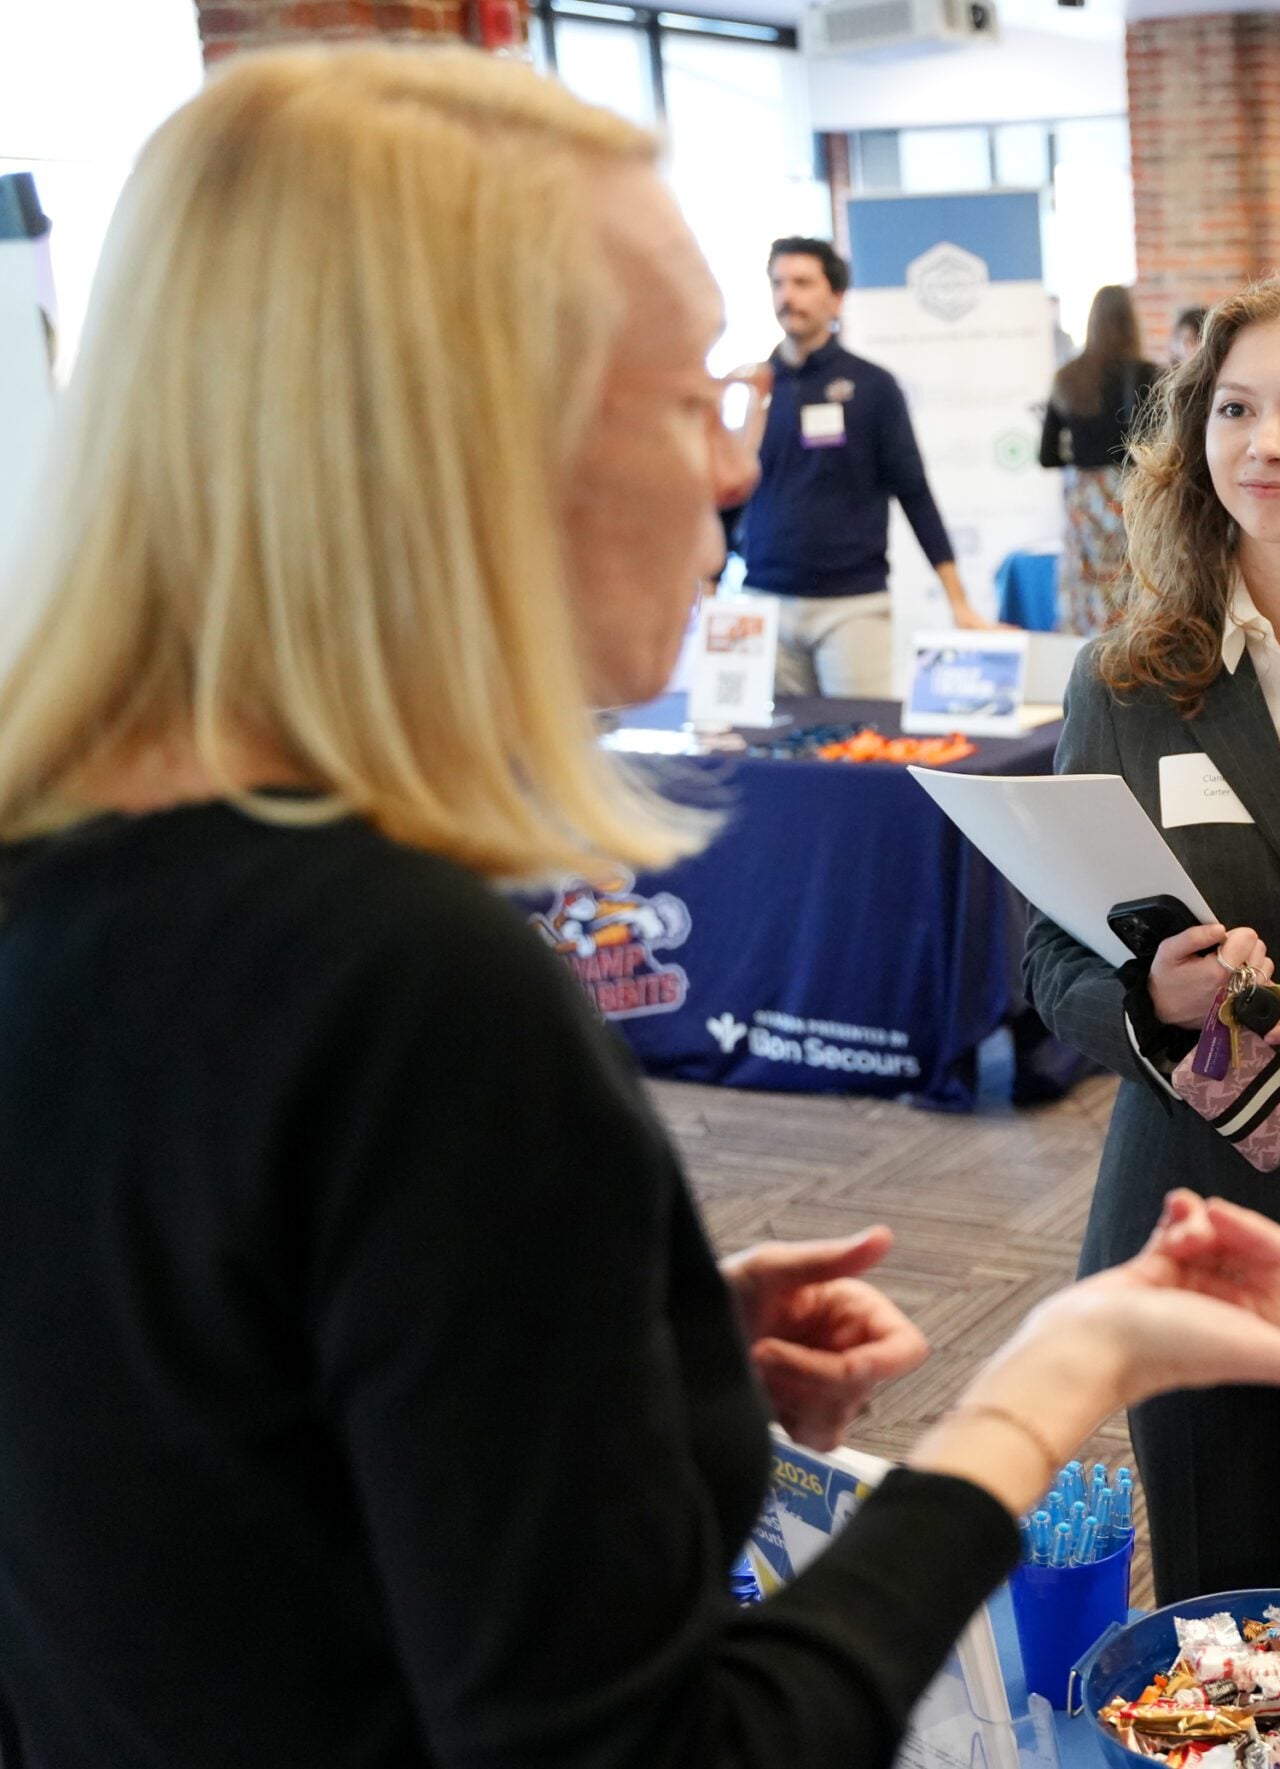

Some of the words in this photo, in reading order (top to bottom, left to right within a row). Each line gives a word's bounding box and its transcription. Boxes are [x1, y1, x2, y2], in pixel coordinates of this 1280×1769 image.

[1203, 787, 1231, 797] Carter
[748, 1027, 803, 1066] Bon
[803, 1036, 921, 1078] Secours
